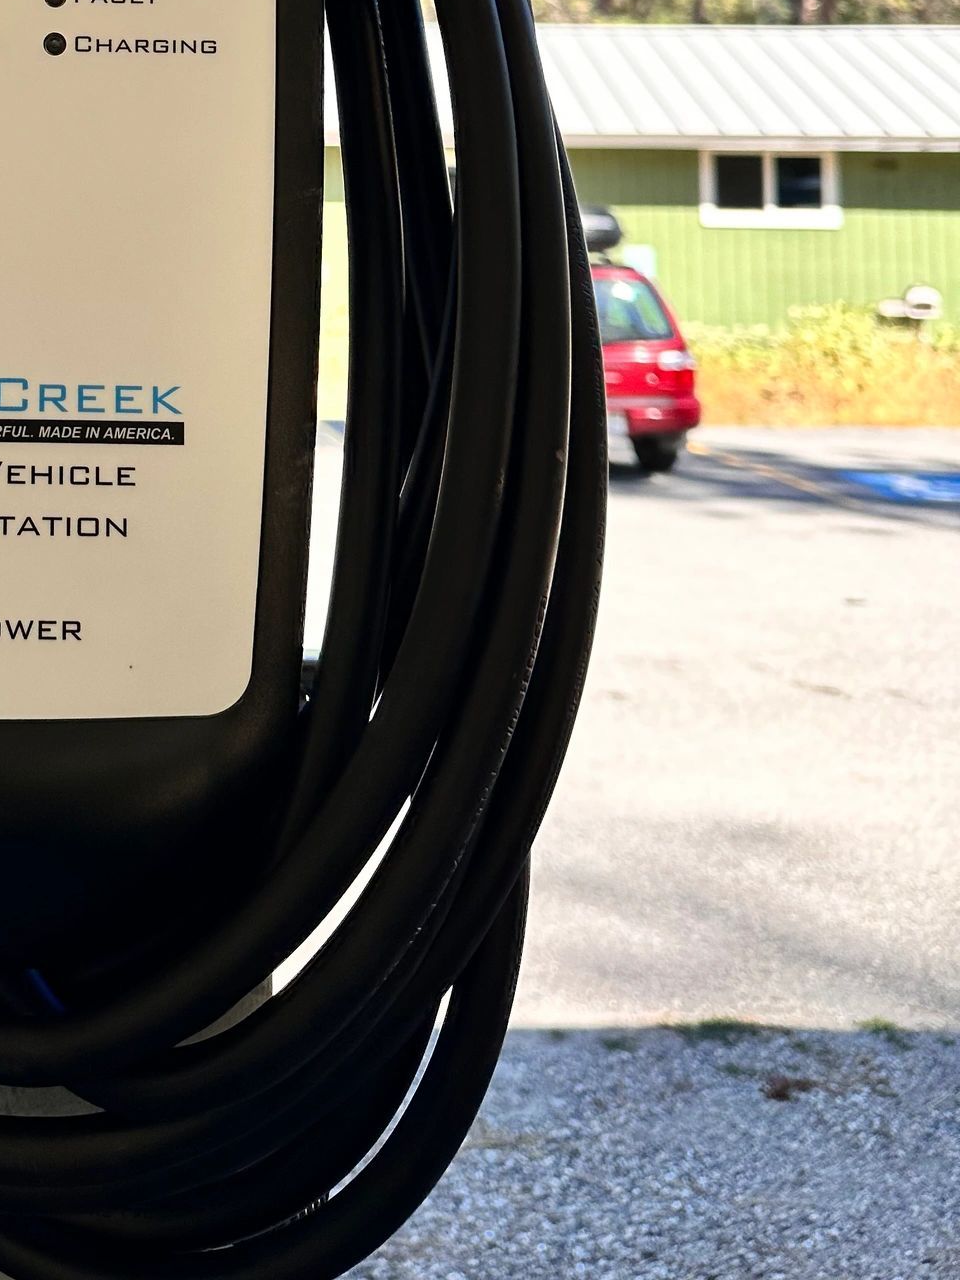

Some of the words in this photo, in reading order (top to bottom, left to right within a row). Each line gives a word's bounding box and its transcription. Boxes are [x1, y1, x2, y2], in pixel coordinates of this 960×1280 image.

[74, 35, 217, 54] CHARGING
[38, 426, 82, 439] MADE
[85, 426, 100, 439] IN
[103, 427, 175, 440] AMERICA.
